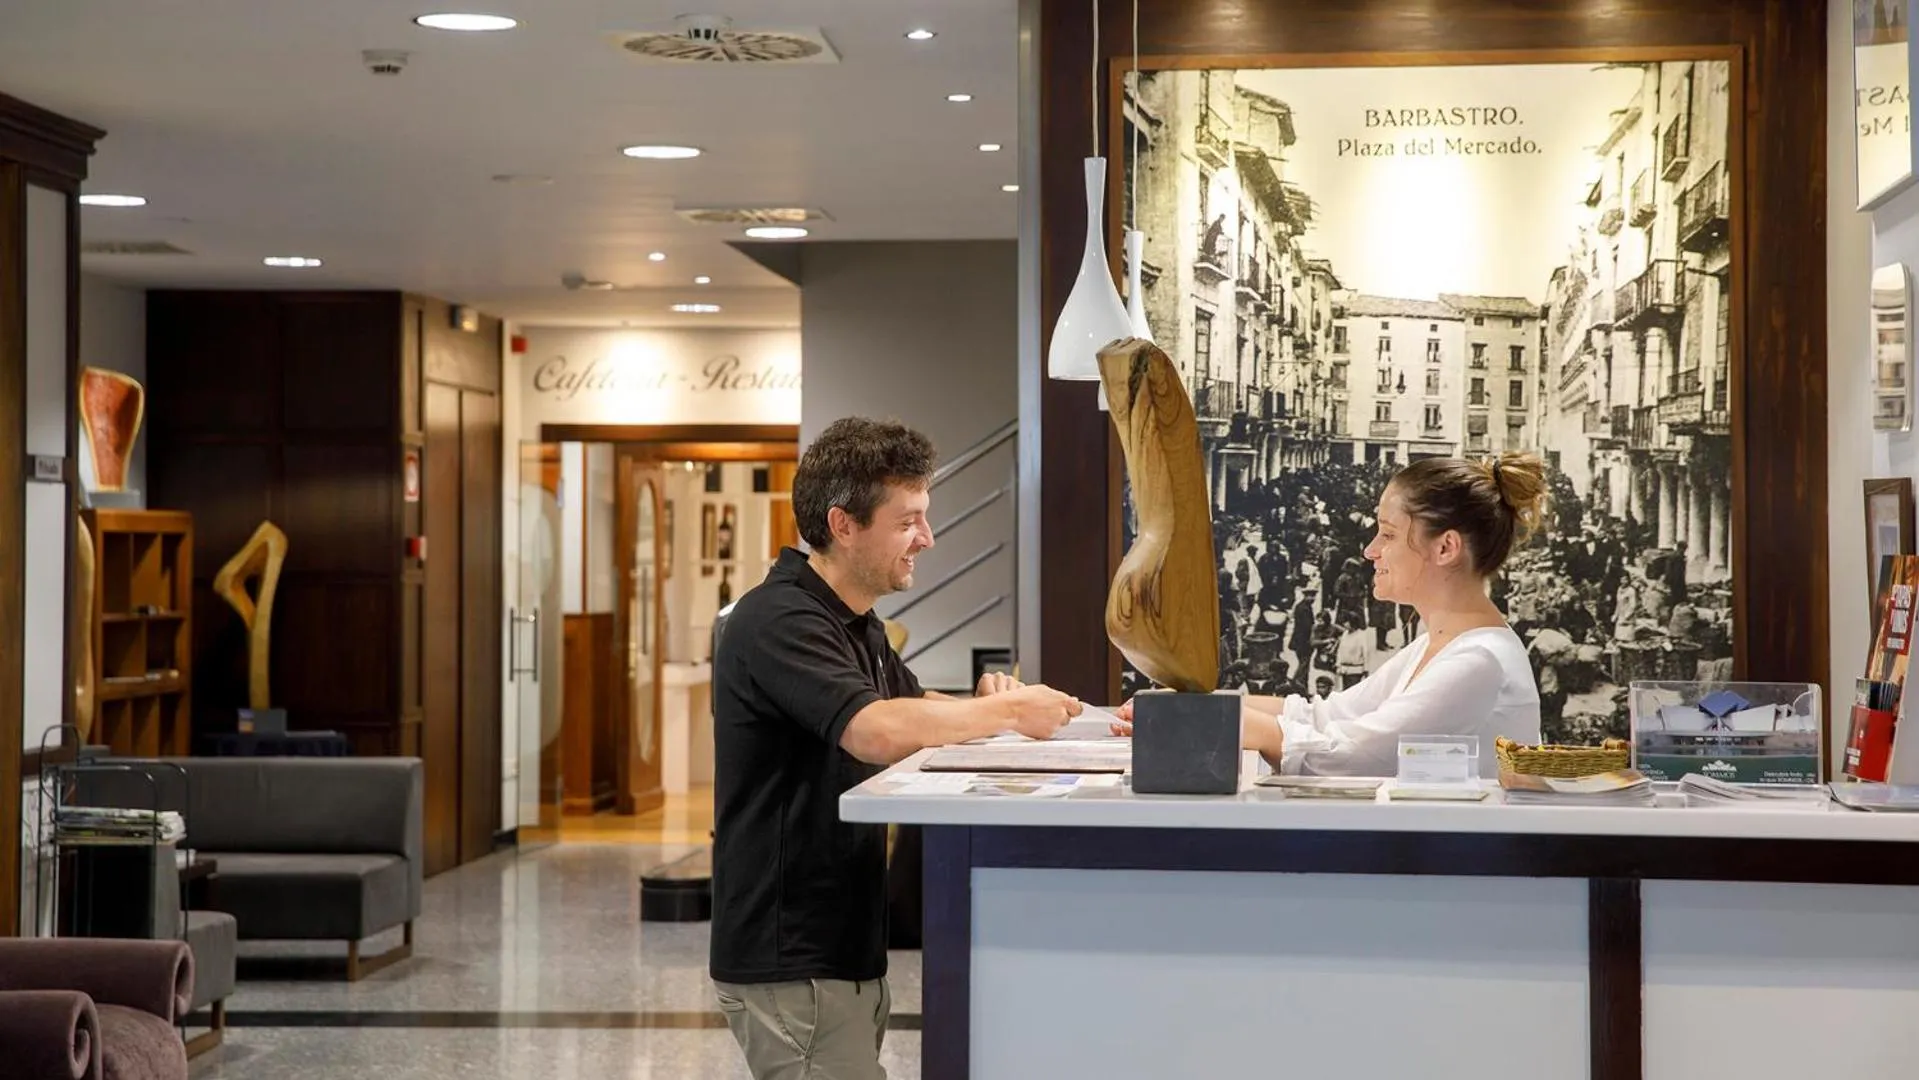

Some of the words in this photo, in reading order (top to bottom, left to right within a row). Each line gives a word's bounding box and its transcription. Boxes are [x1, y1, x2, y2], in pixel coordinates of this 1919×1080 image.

[1365, 106, 1524, 128] BARBASTRO.
[1337, 138, 1394, 157] Plaza
[1404, 137, 1435, 156] del
[1444, 136, 1543, 156] Mercado.
